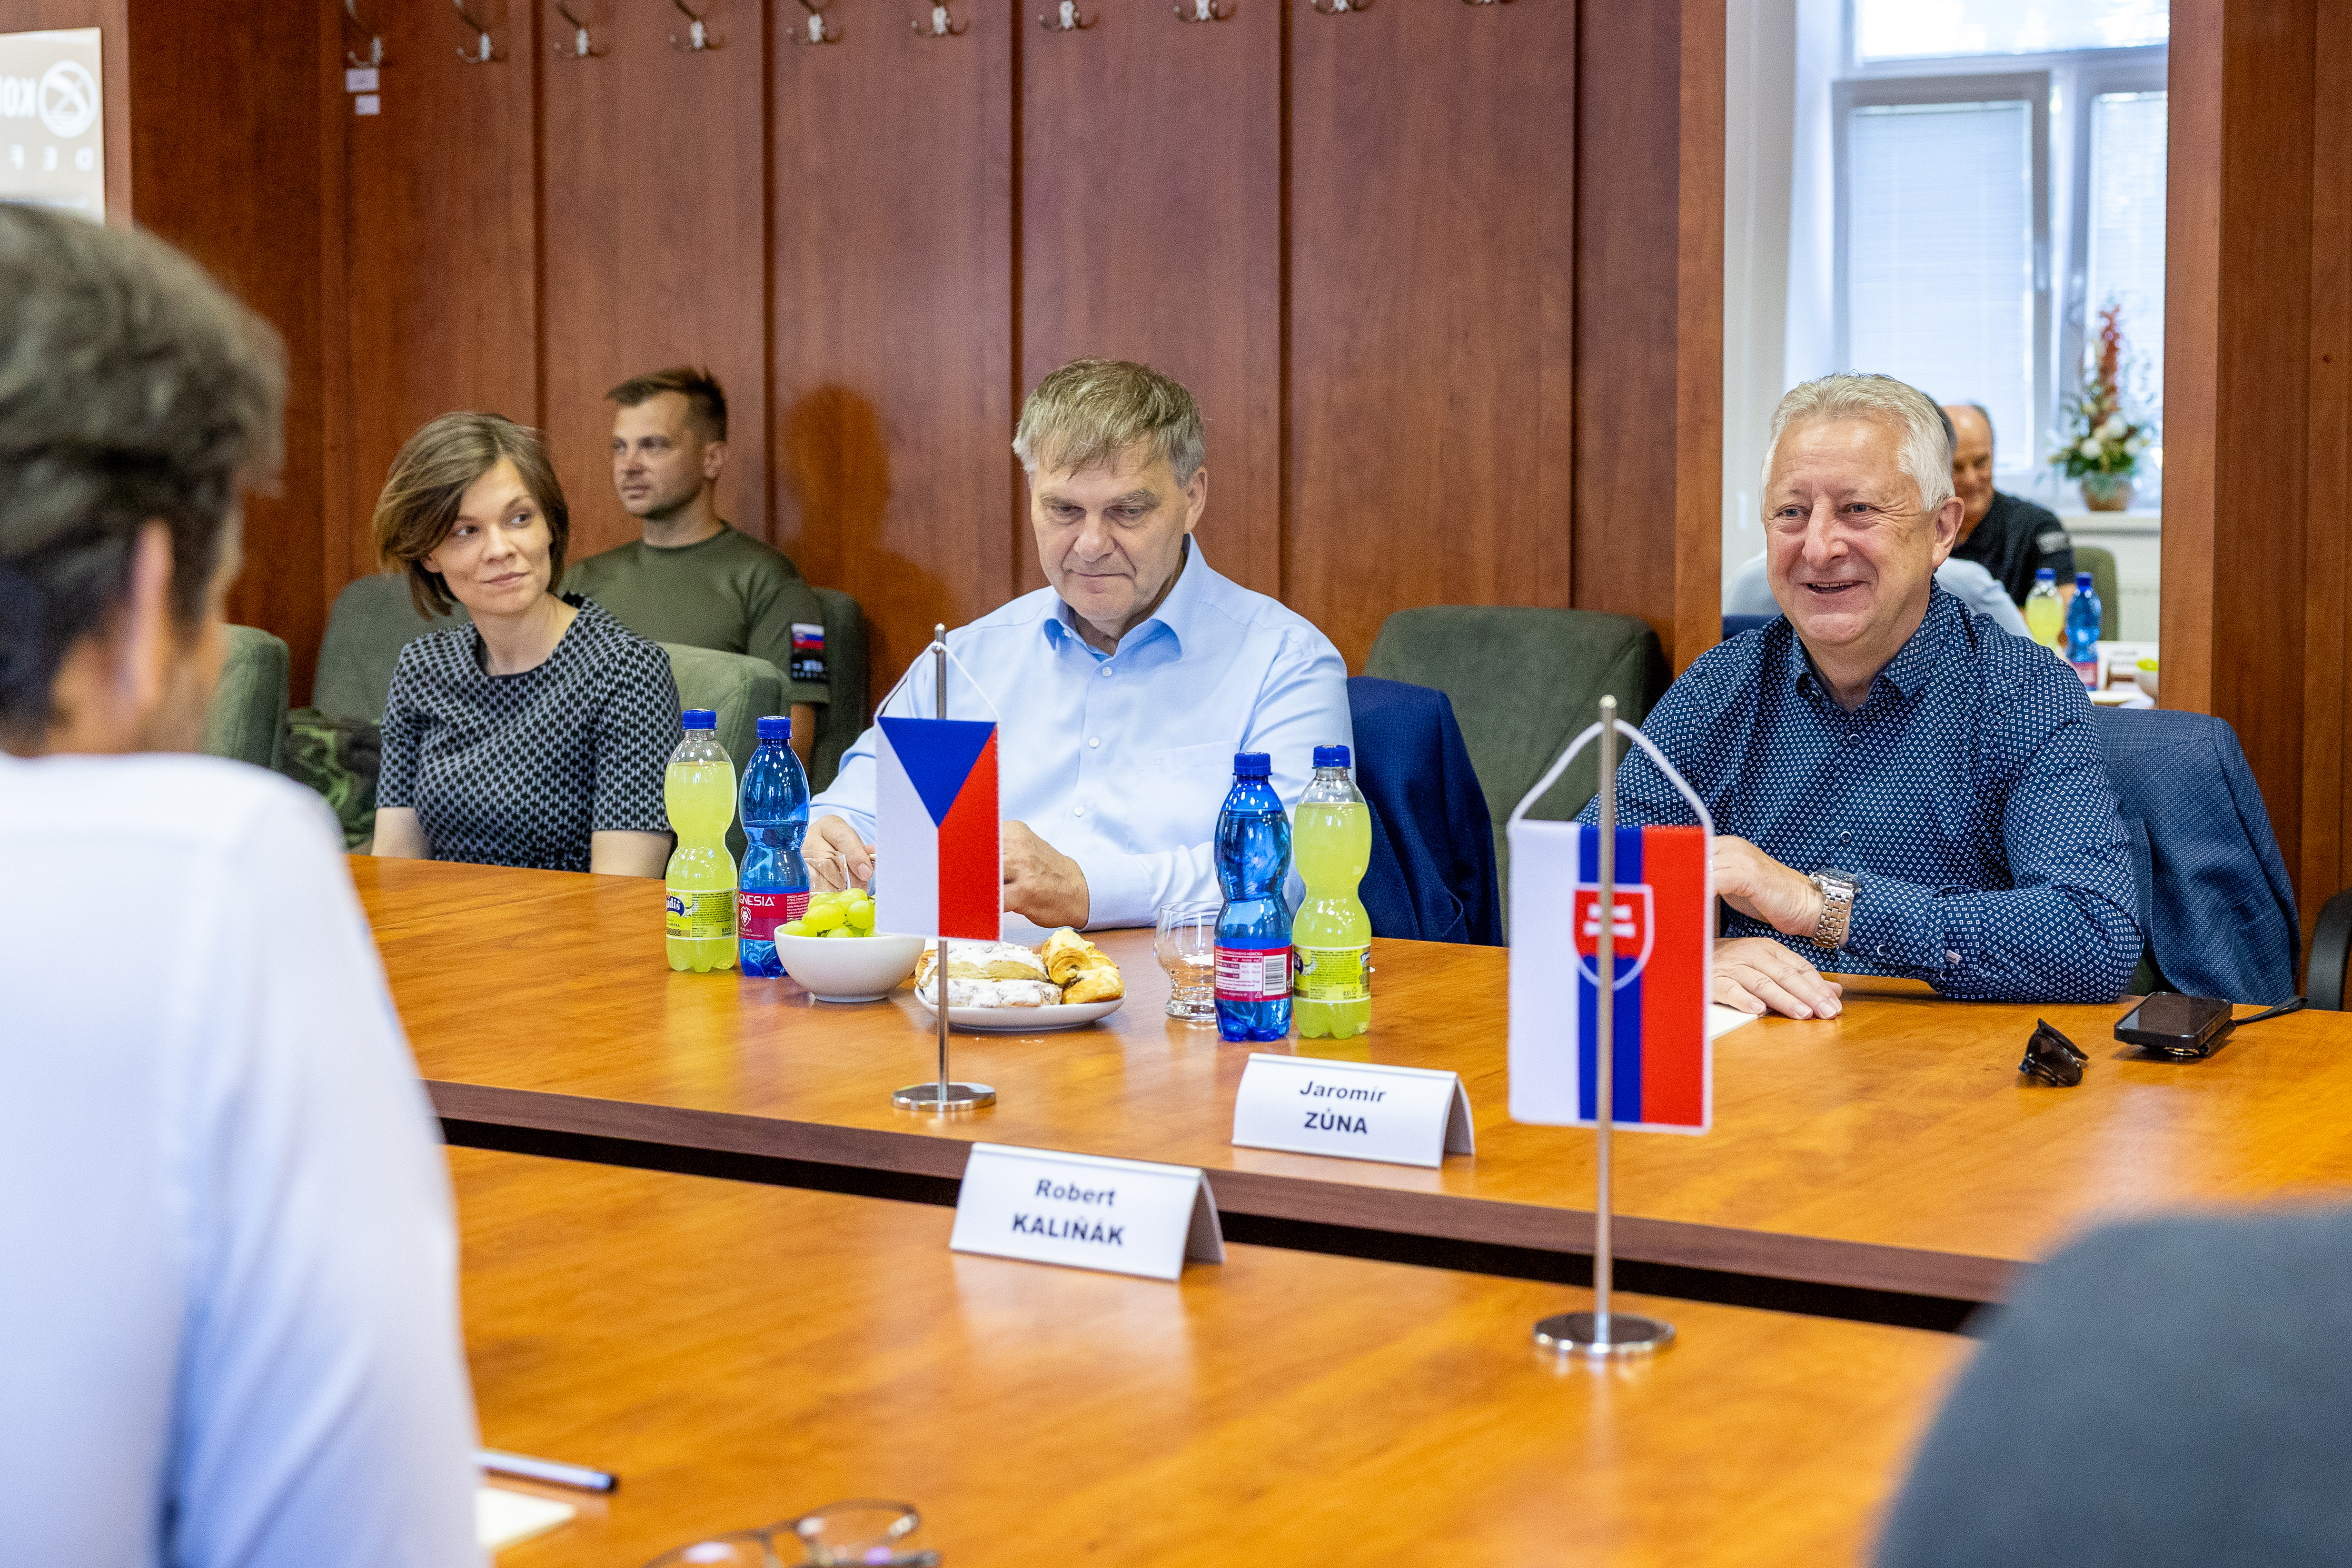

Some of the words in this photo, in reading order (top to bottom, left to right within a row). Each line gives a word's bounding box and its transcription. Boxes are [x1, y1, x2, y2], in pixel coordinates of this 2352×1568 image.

[1300, 1081, 1387, 1102] Jaromír
[1035, 1178, 1116, 1207] Robert
[1012, 1212, 1125, 1247] KALIŇÁK
